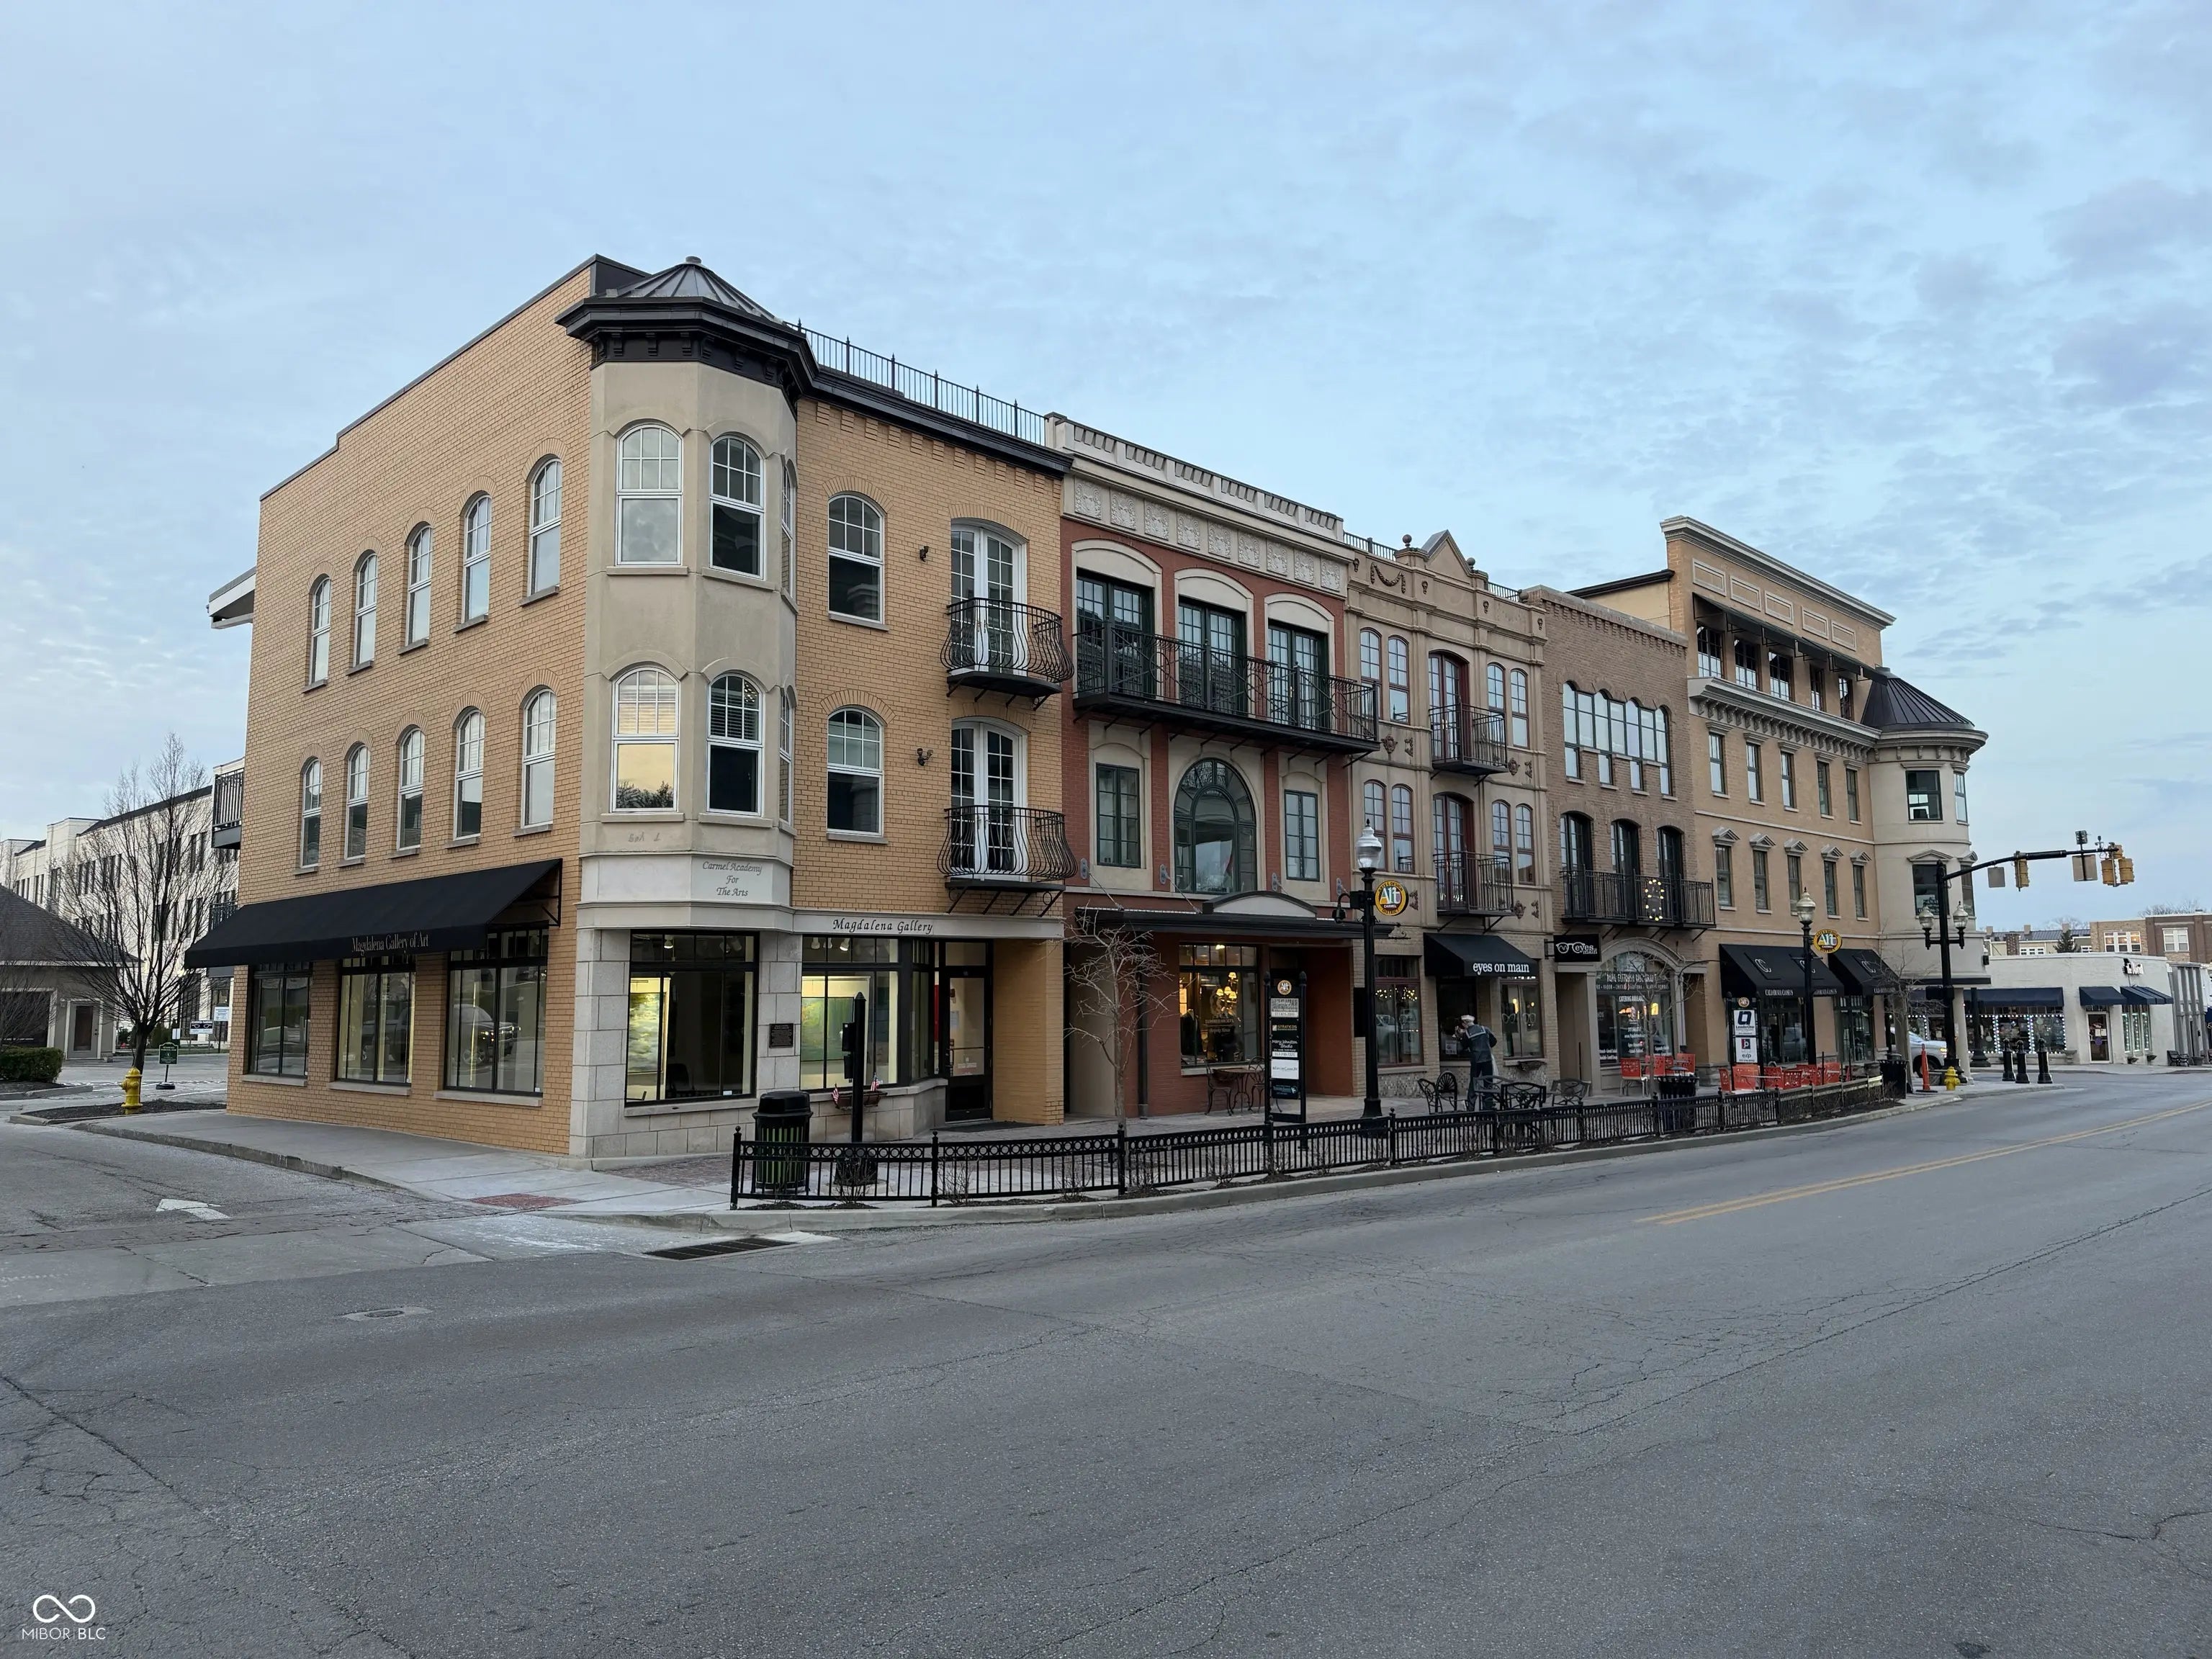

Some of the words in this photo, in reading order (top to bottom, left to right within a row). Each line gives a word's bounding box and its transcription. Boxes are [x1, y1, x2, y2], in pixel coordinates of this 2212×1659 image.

[702, 861, 730, 871] Carmel
[730, 863, 763, 876] Academy
[726, 875, 739, 884] For
[716, 886, 731, 896] The
[732, 888, 749, 896] Arts
[833, 917, 893, 933] Magdalena
[897, 920, 933, 935] Gallery
[351, 936, 385, 956] Magdalena
[385, 934, 409, 953] Gallery
[409, 932, 418, 948] of
[418, 931, 428, 947] Art
[1473, 963, 1493, 976] eyes
[1494, 963, 1506, 973] on
[1507, 963, 1530, 973] main
